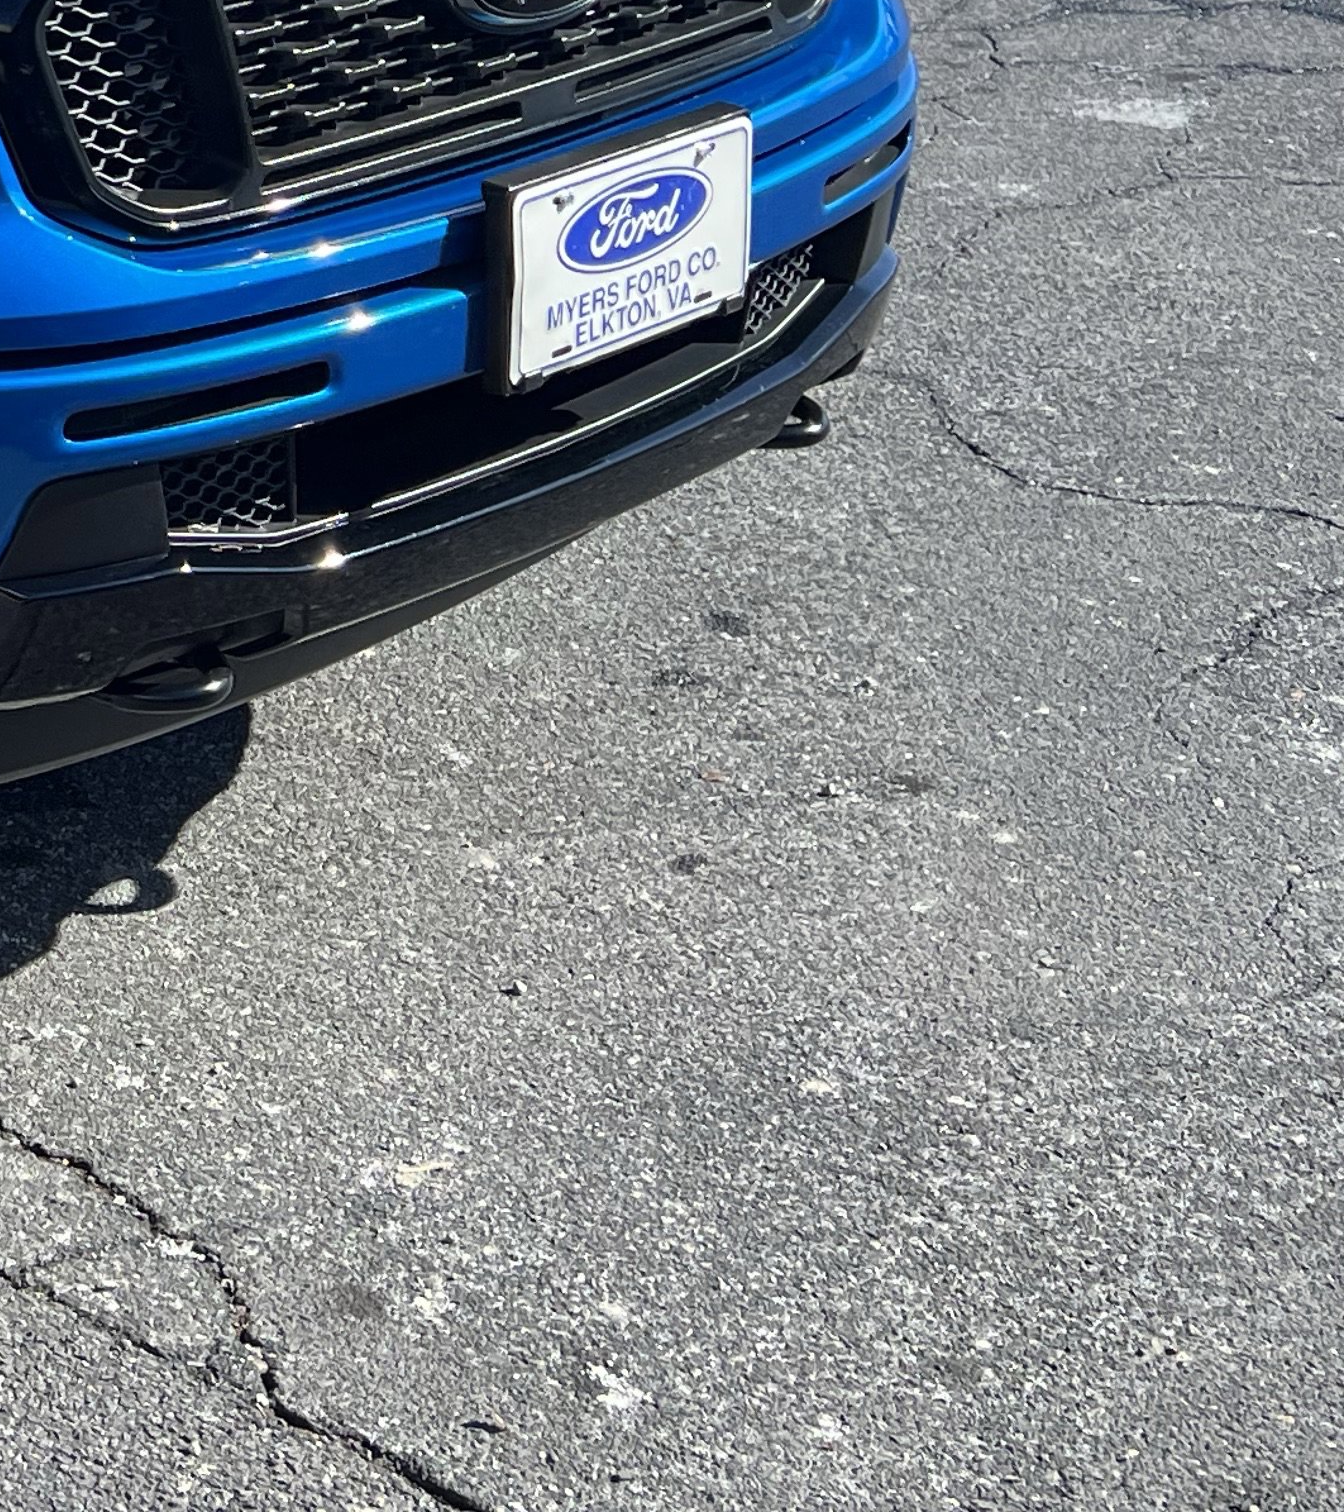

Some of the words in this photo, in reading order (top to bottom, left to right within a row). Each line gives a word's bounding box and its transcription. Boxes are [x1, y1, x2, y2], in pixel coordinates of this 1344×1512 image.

[590, 183, 681, 258] Ford
[547, 282, 619, 331] MYERS
[625, 259, 681, 301] FORD
[687, 246, 721, 277] CO.
